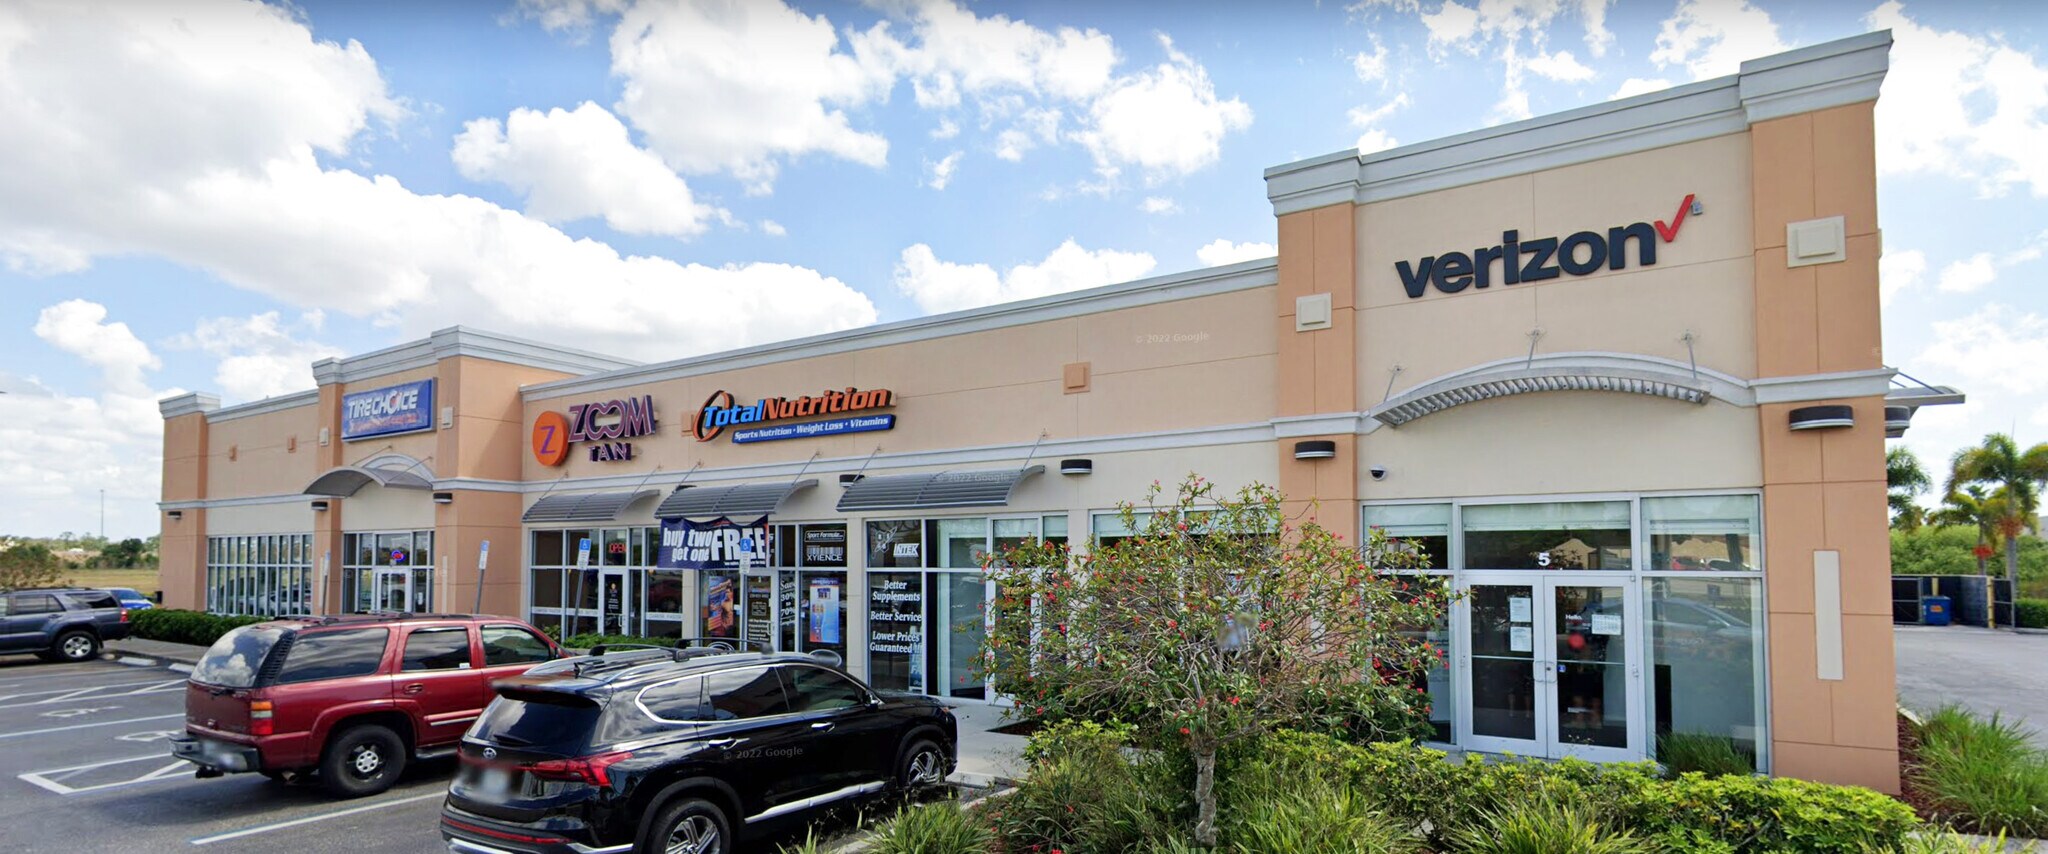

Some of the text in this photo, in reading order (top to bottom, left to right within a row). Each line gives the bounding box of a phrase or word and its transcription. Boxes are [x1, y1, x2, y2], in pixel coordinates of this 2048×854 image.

[1395, 222, 1657, 298] verizon
[568, 395, 656, 443] ZOOM
[734, 417, 889, 441] Sports Nutrition Weight Loss Vitamins
[588, 443, 632, 462] TAN
[663, 528, 713, 548] buy two
[671, 547, 710, 563] get one
[1538, 552, 1551, 567] 5
[884, 580, 907, 590] Better
[872, 591, 921, 603] Supplements
[870, 611, 922, 622] Better Service
[872, 631, 920, 642] Lower Prices
[870, 642, 913, 654] Guaranteed
